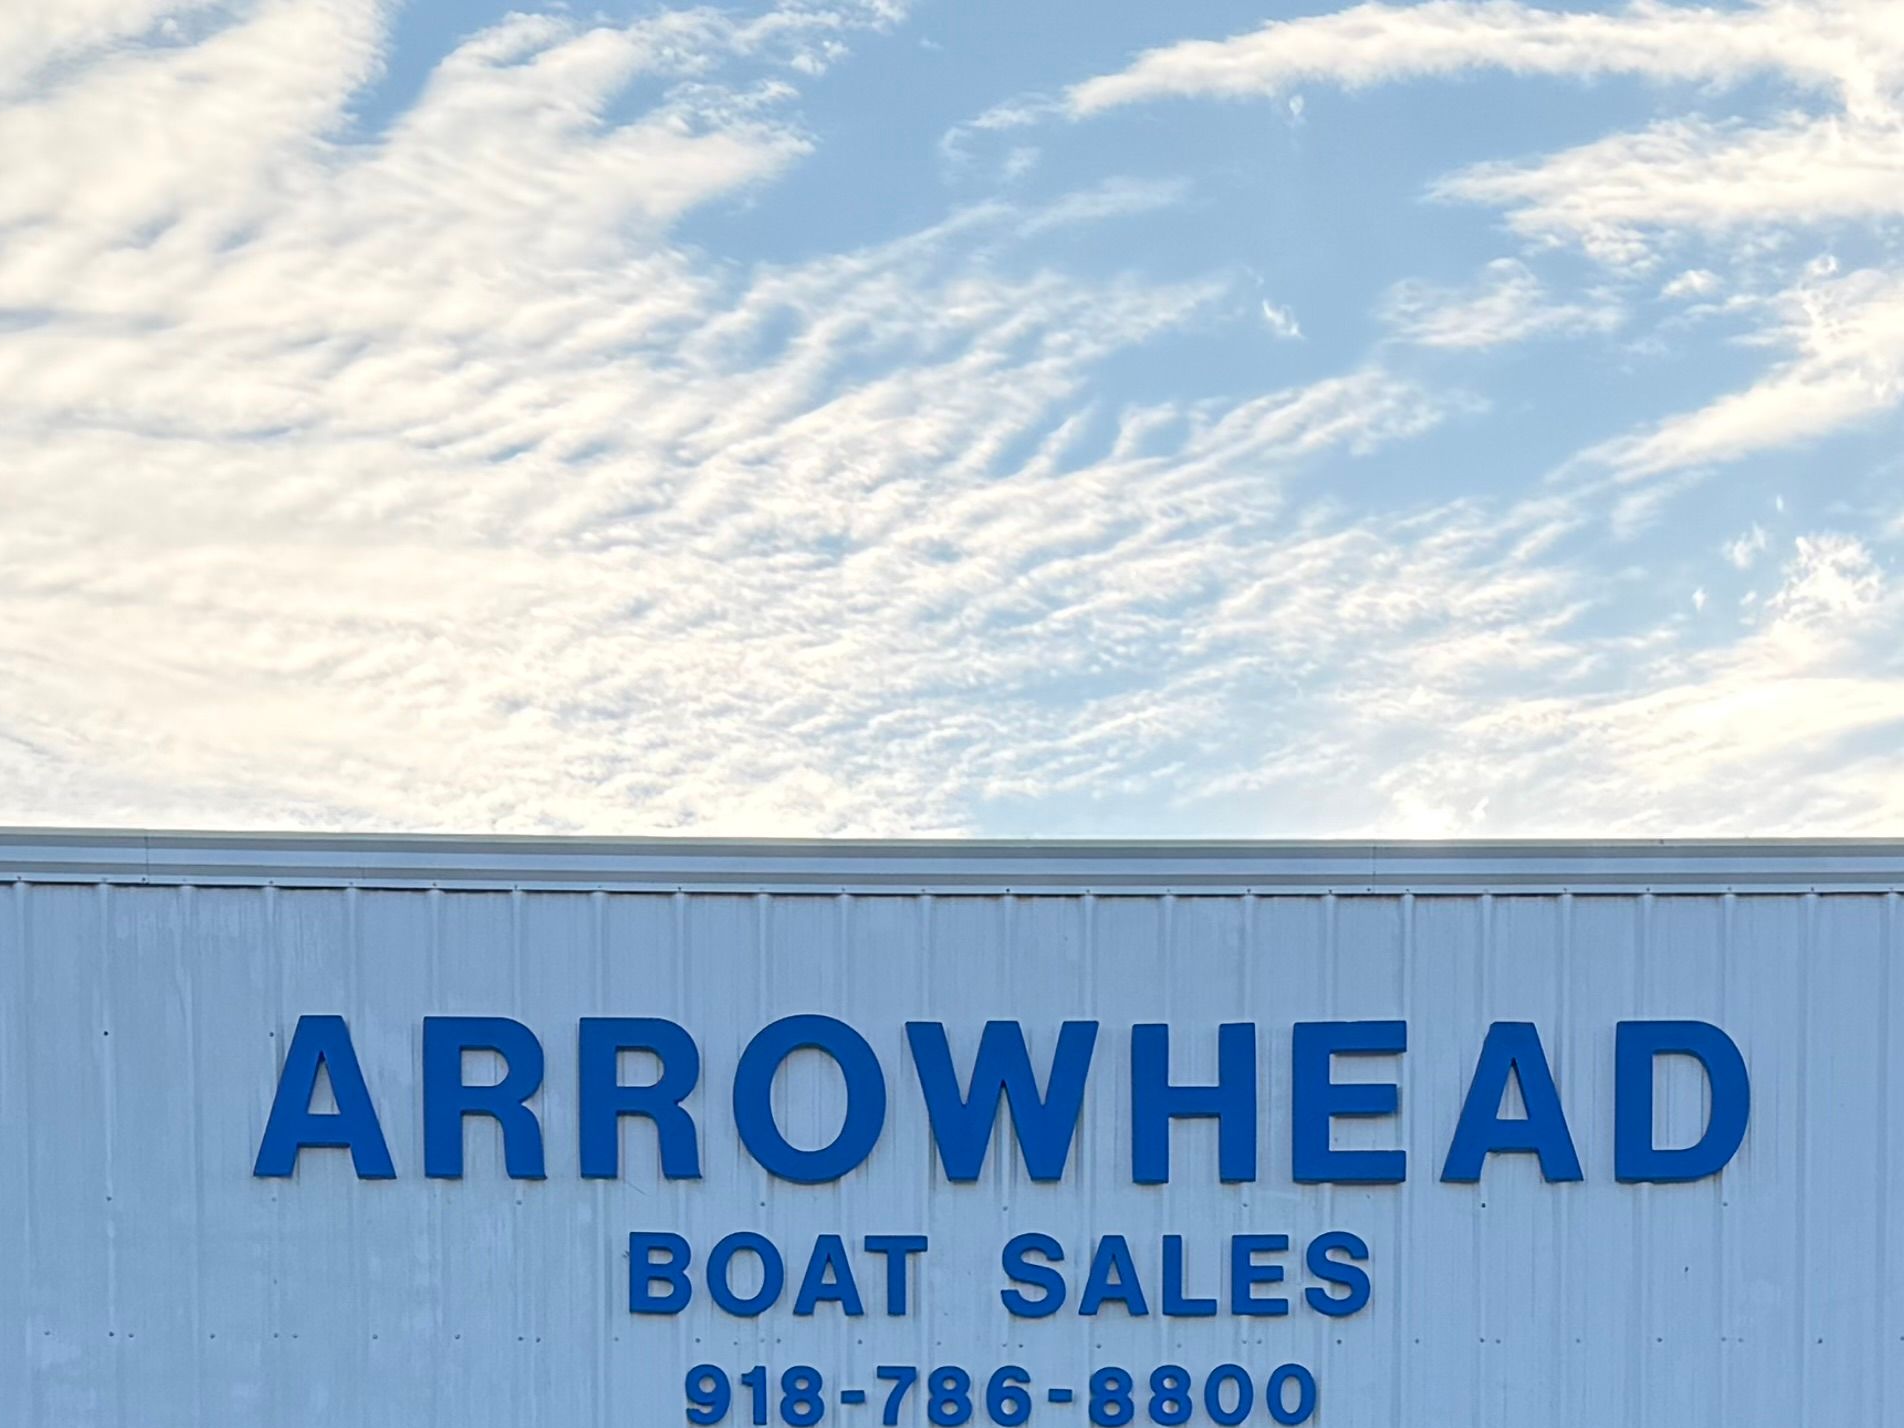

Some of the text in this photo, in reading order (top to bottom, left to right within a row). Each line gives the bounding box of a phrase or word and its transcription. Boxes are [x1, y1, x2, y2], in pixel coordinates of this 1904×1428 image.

[253, 1013, 1752, 1185] ARROWHEAD
[627, 1230, 1372, 1320] BOAT SALES
[684, 1362, 1318, 1428] 918-786-8800
